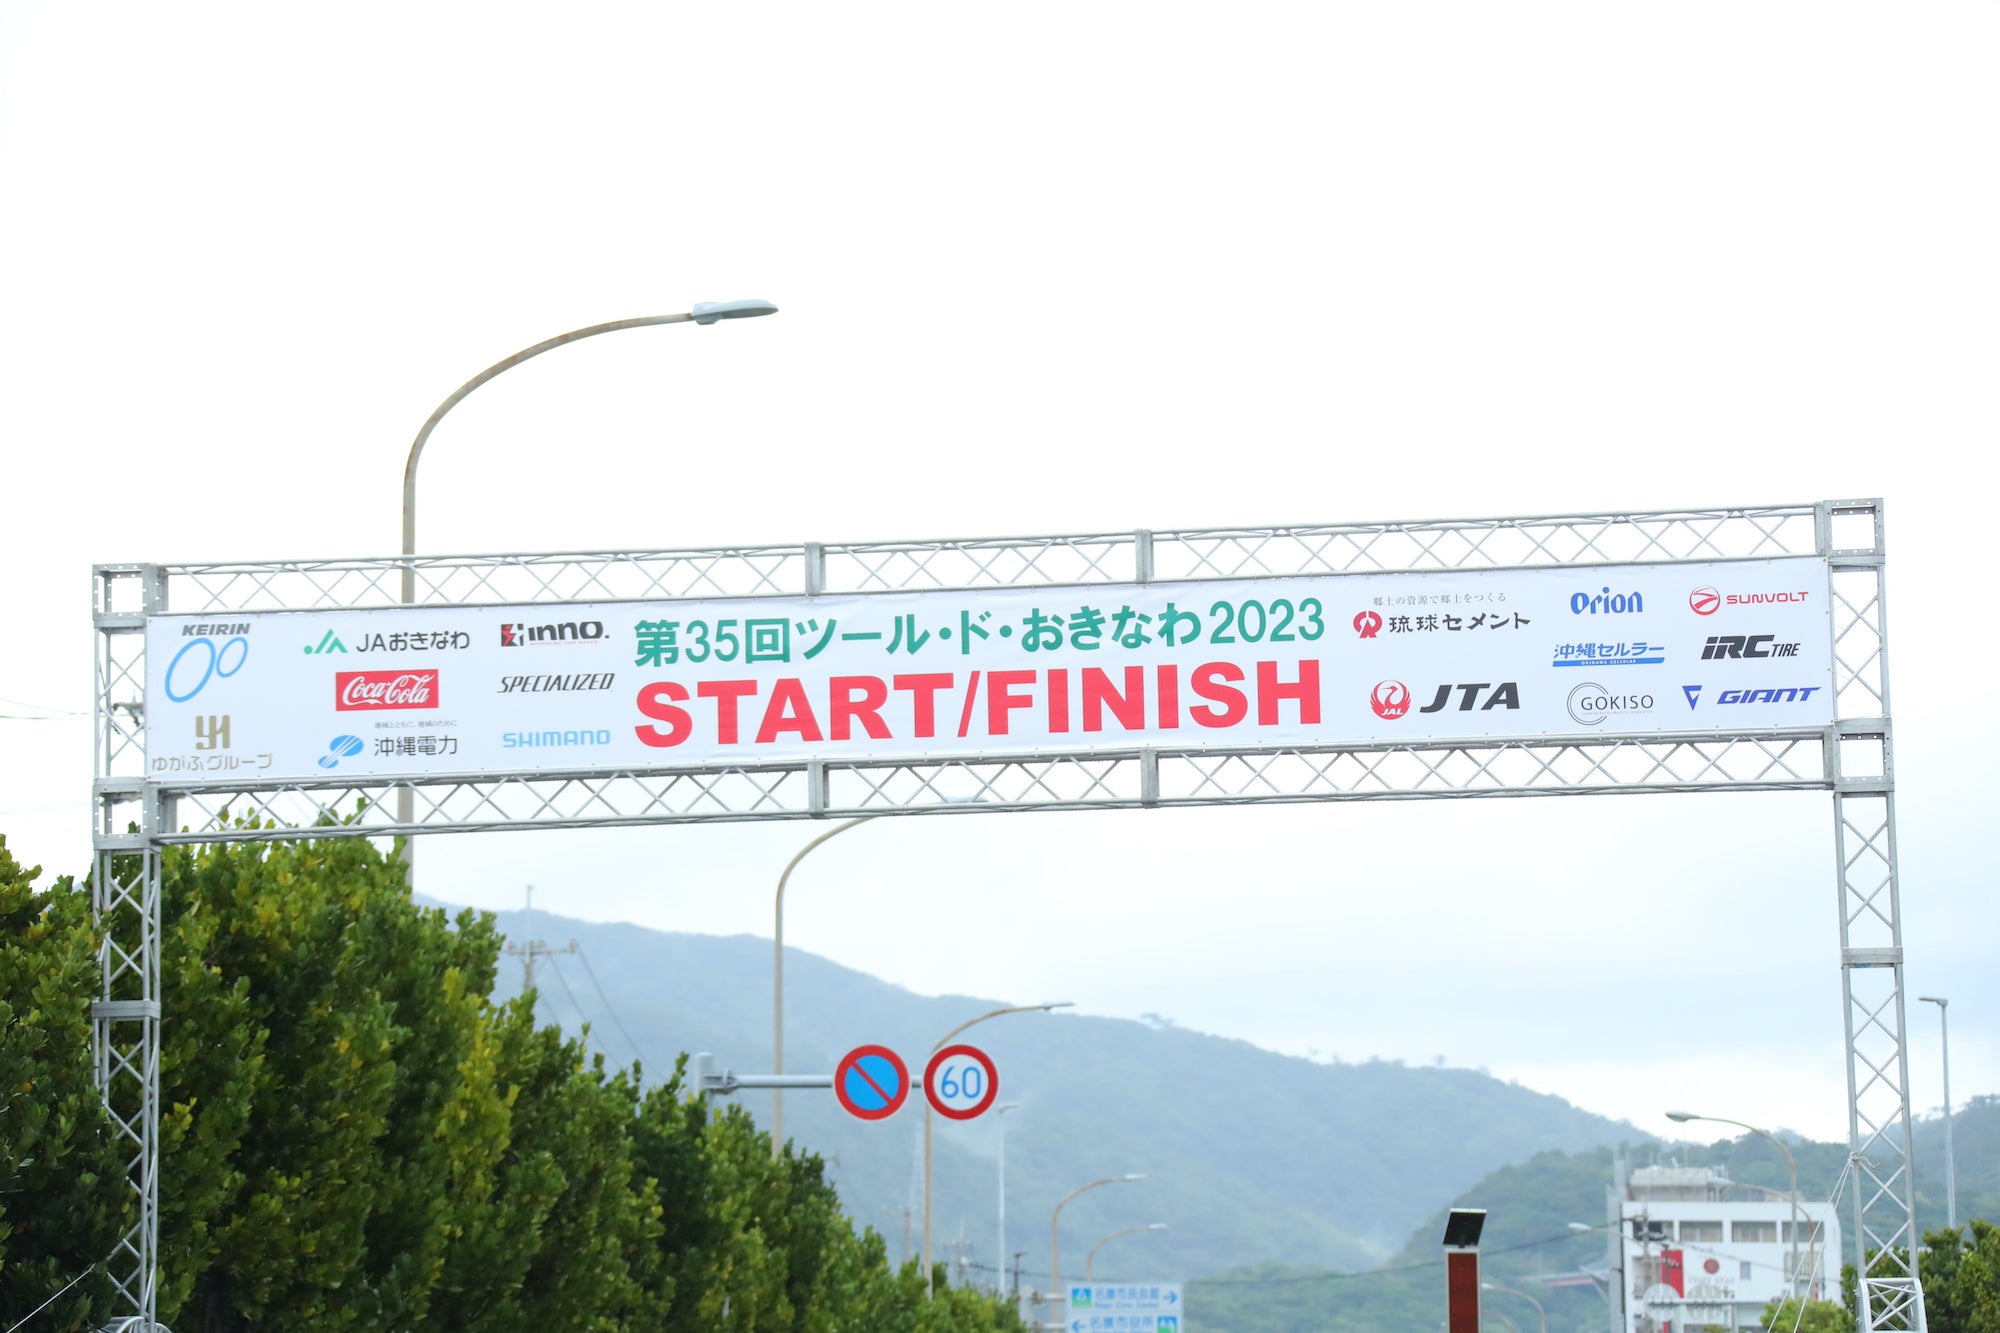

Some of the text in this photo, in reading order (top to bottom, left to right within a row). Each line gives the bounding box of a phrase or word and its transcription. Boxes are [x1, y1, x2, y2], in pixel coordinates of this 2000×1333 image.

[1373, 593, 1507, 606] 郷土の資源で郷土をつくる
[1570, 586, 1643, 615] Orion
[1726, 592, 1809, 605] SUNVOLT
[182, 623, 251, 636] KEIRIN
[634, 598, 1325, 667] 第35回ツール・ド・おきなわ2023
[1389, 612, 1531, 633] 琉球セメント
[356, 630, 470, 653] JAおきなわ
[1553, 642, 1665, 659] 沖縄セルラー
[1771, 643, 1801, 658] TIRE
[341, 674, 436, 706] Coca-Cola
[497, 673, 615, 694] SPECIALIZED
[635, 659, 1321, 748] START/FINISH
[1419, 682, 1521, 713] JTA
[1581, 694, 1654, 711] GOKISO
[1717, 687, 1822, 704] GIANT
[374, 735, 458, 757] 沖縄電力
[502, 730, 610, 748] SHIMANO
[151, 754, 273, 772] ゆがふグループ
[941, 1066, 981, 1099] 60
